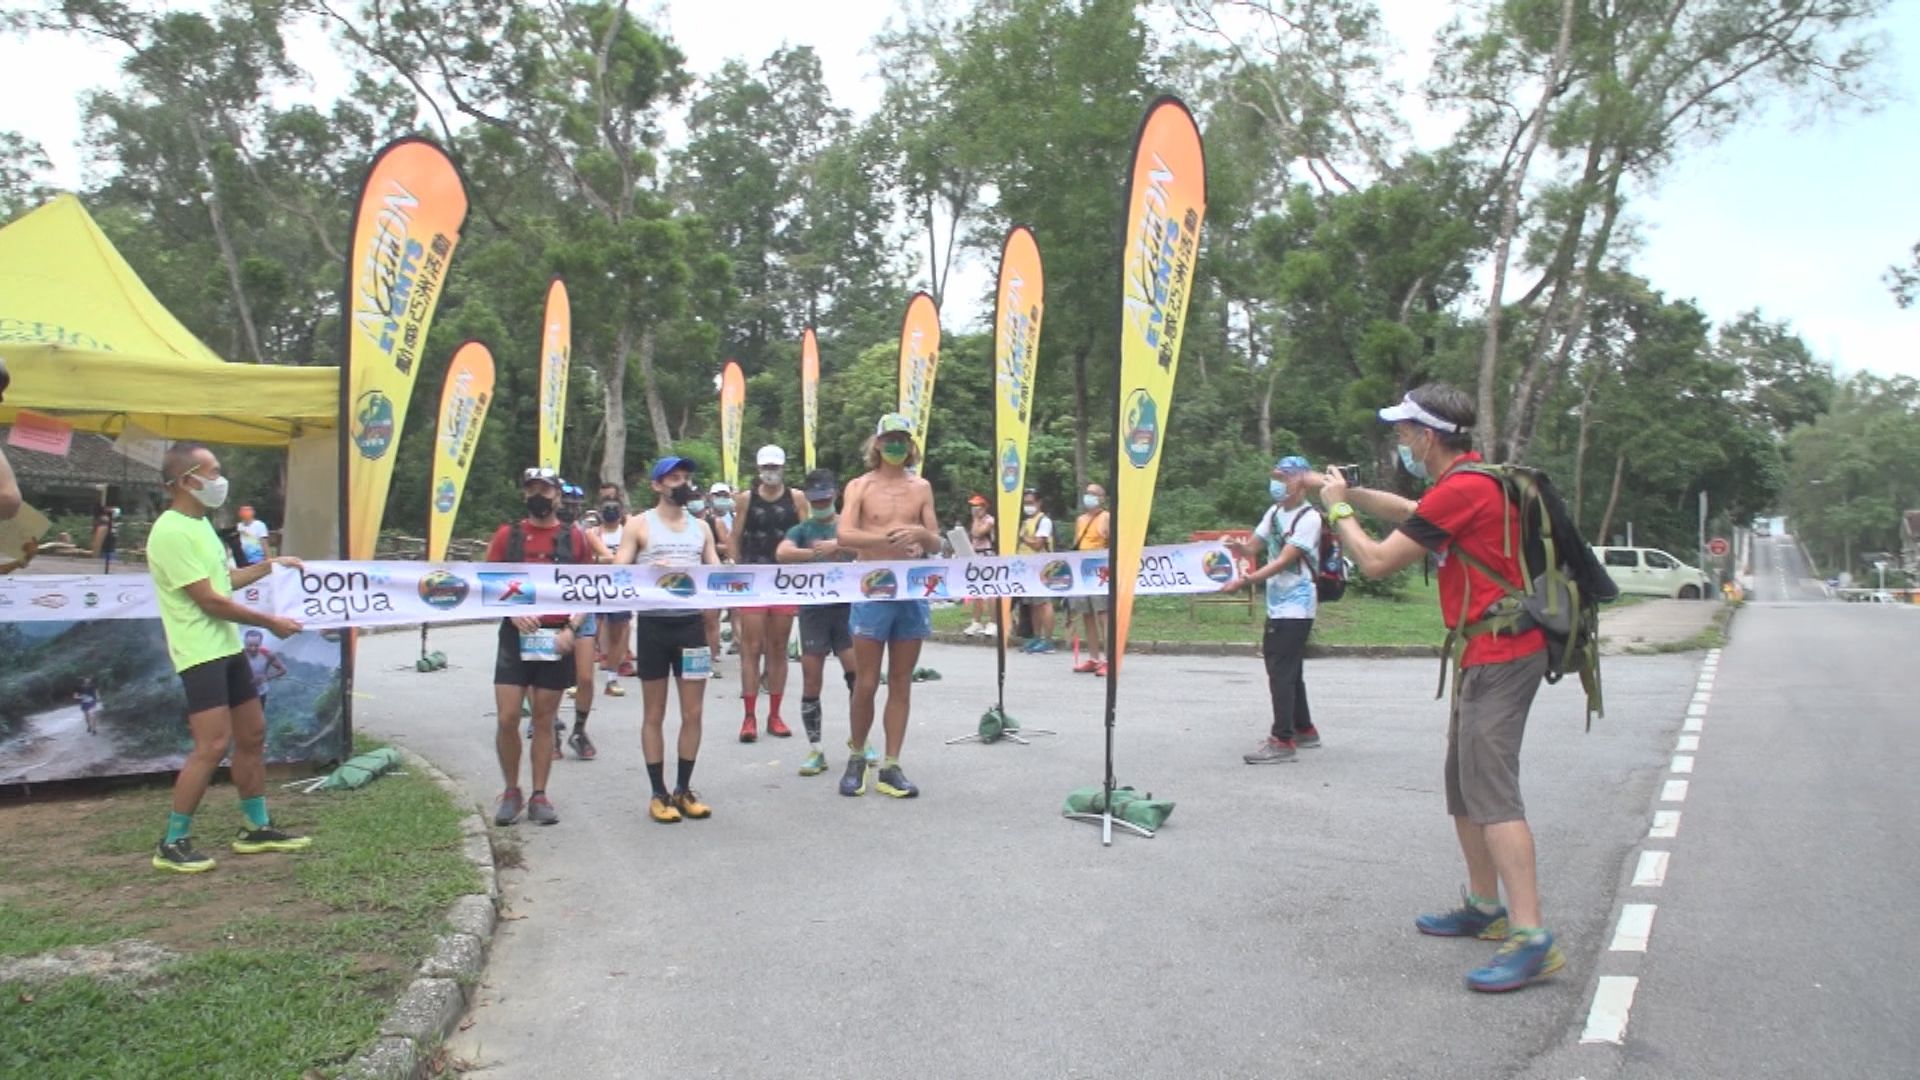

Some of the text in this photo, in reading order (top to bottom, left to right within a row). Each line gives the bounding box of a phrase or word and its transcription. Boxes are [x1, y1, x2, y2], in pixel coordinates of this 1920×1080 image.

[301, 568, 369, 594] bon
[774, 567, 824, 590] bon
[965, 562, 1009, 582] bon
[1138, 570, 1191, 588] aqua
[304, 592, 394, 621] aqua
